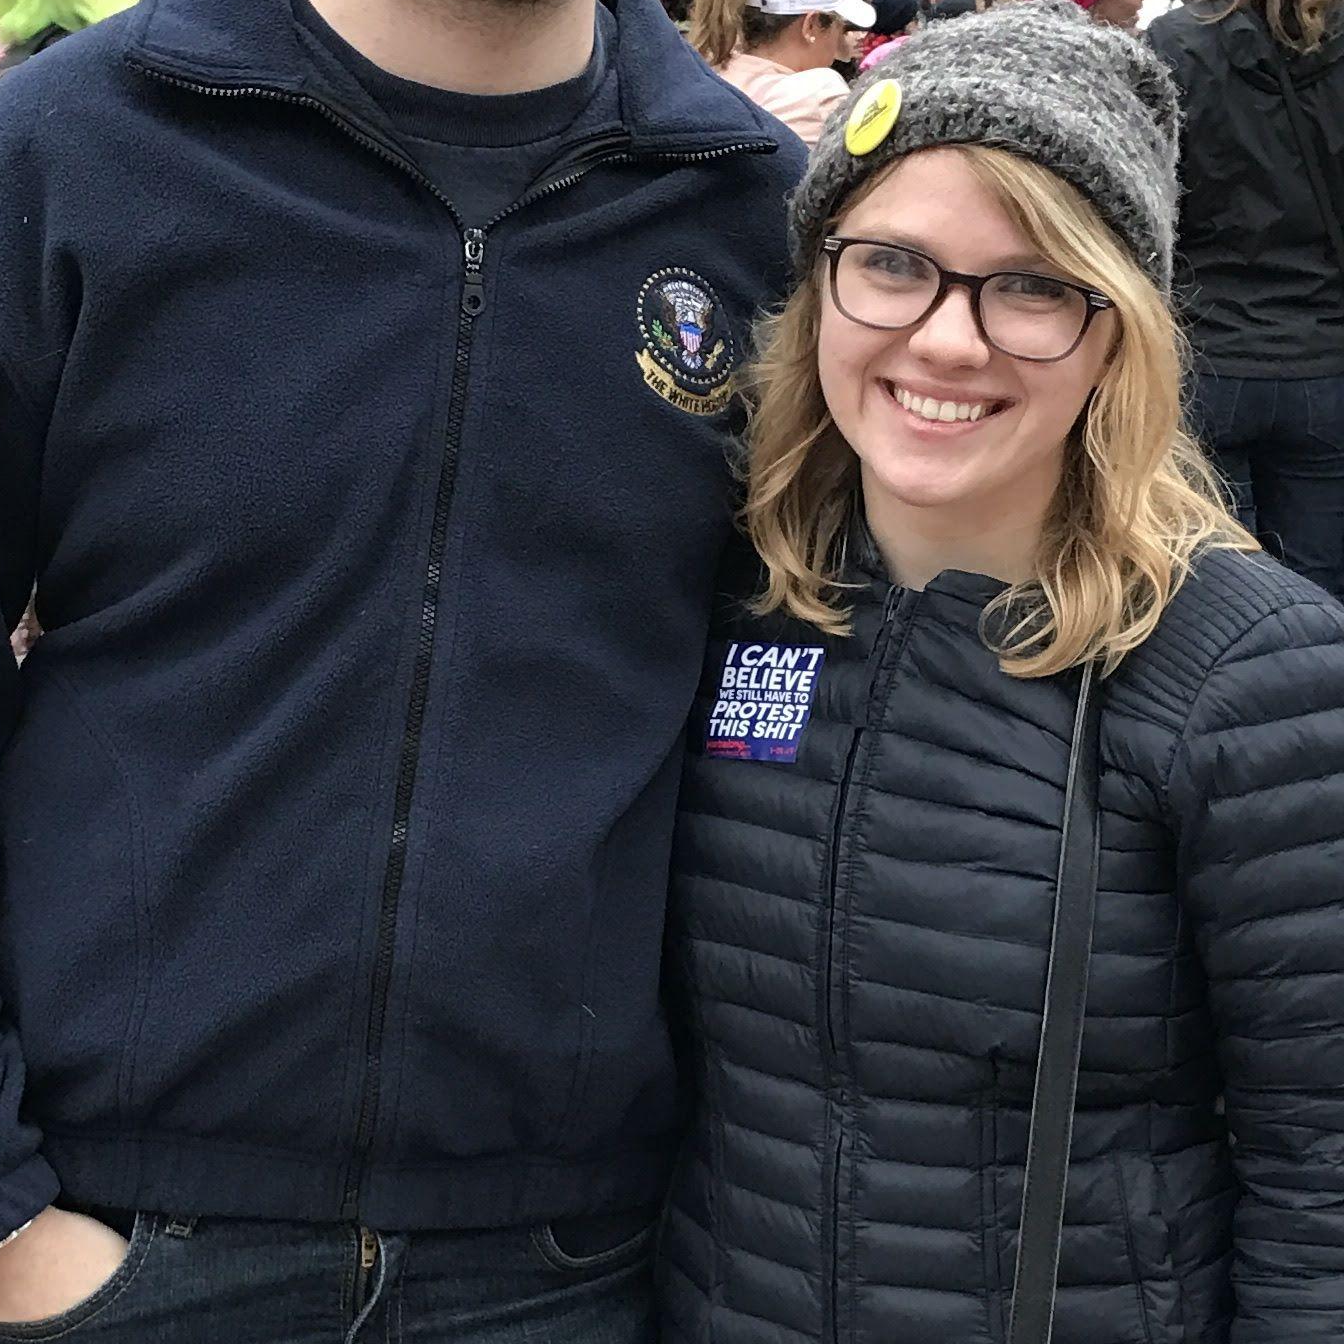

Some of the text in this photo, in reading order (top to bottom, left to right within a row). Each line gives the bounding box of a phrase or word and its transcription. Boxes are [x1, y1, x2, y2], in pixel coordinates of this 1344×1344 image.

[645, 369, 668, 396] THE
[668, 388, 700, 413] WHITE
[725, 643, 825, 670] I CAN'T
[721, 666, 816, 692] BELIEVE
[719, 689, 809, 704] WE STILL HAVE TO
[711, 700, 809, 724] PROTEST
[709, 718, 803, 741] THIS SHIT
